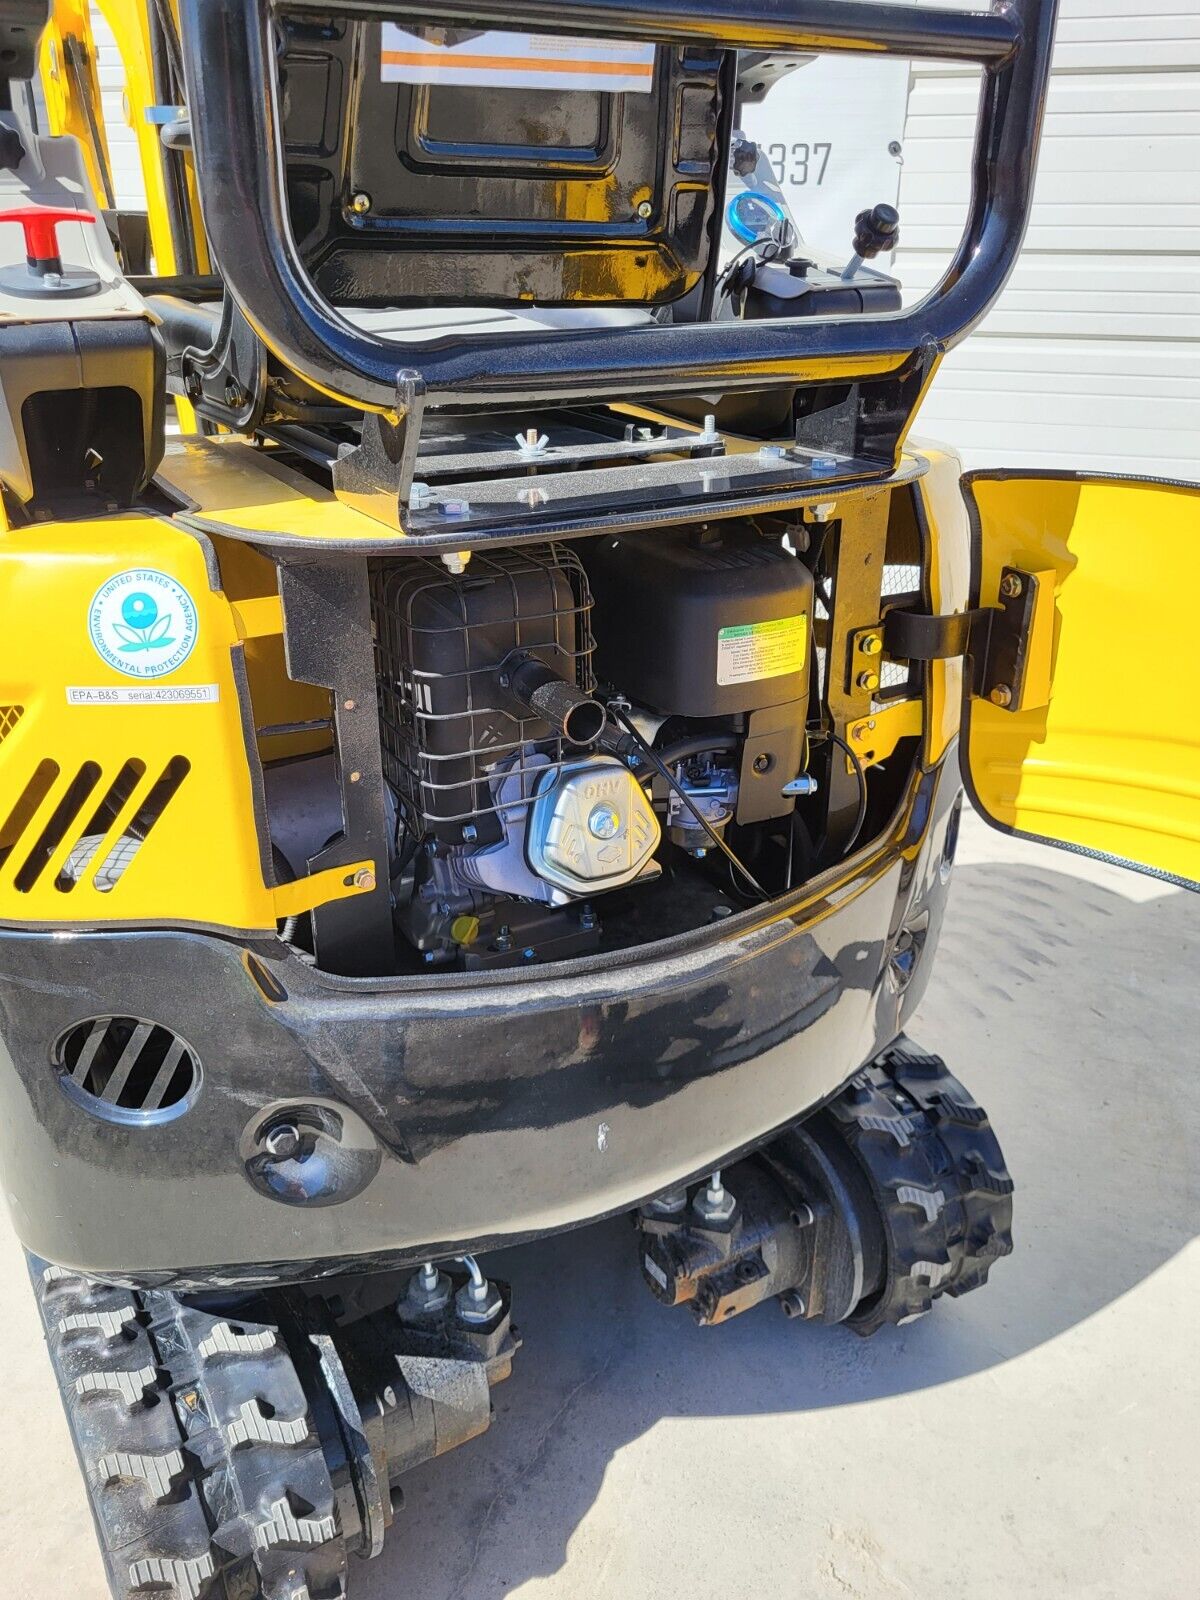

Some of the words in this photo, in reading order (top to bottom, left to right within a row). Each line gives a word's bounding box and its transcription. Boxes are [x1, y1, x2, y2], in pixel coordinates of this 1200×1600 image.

[757, 143, 832, 186] 337
[102, 573, 133, 598] UNITED
[135, 573, 170, 589] STATES
[92, 608, 142, 674] ENVIRONMENTAL
[144, 636, 192, 674] PROTECTION
[176, 593, 194, 633] AGENCY
[71, 690, 119, 701] EPA-B&S
[583, 779, 621, 800] OHV
